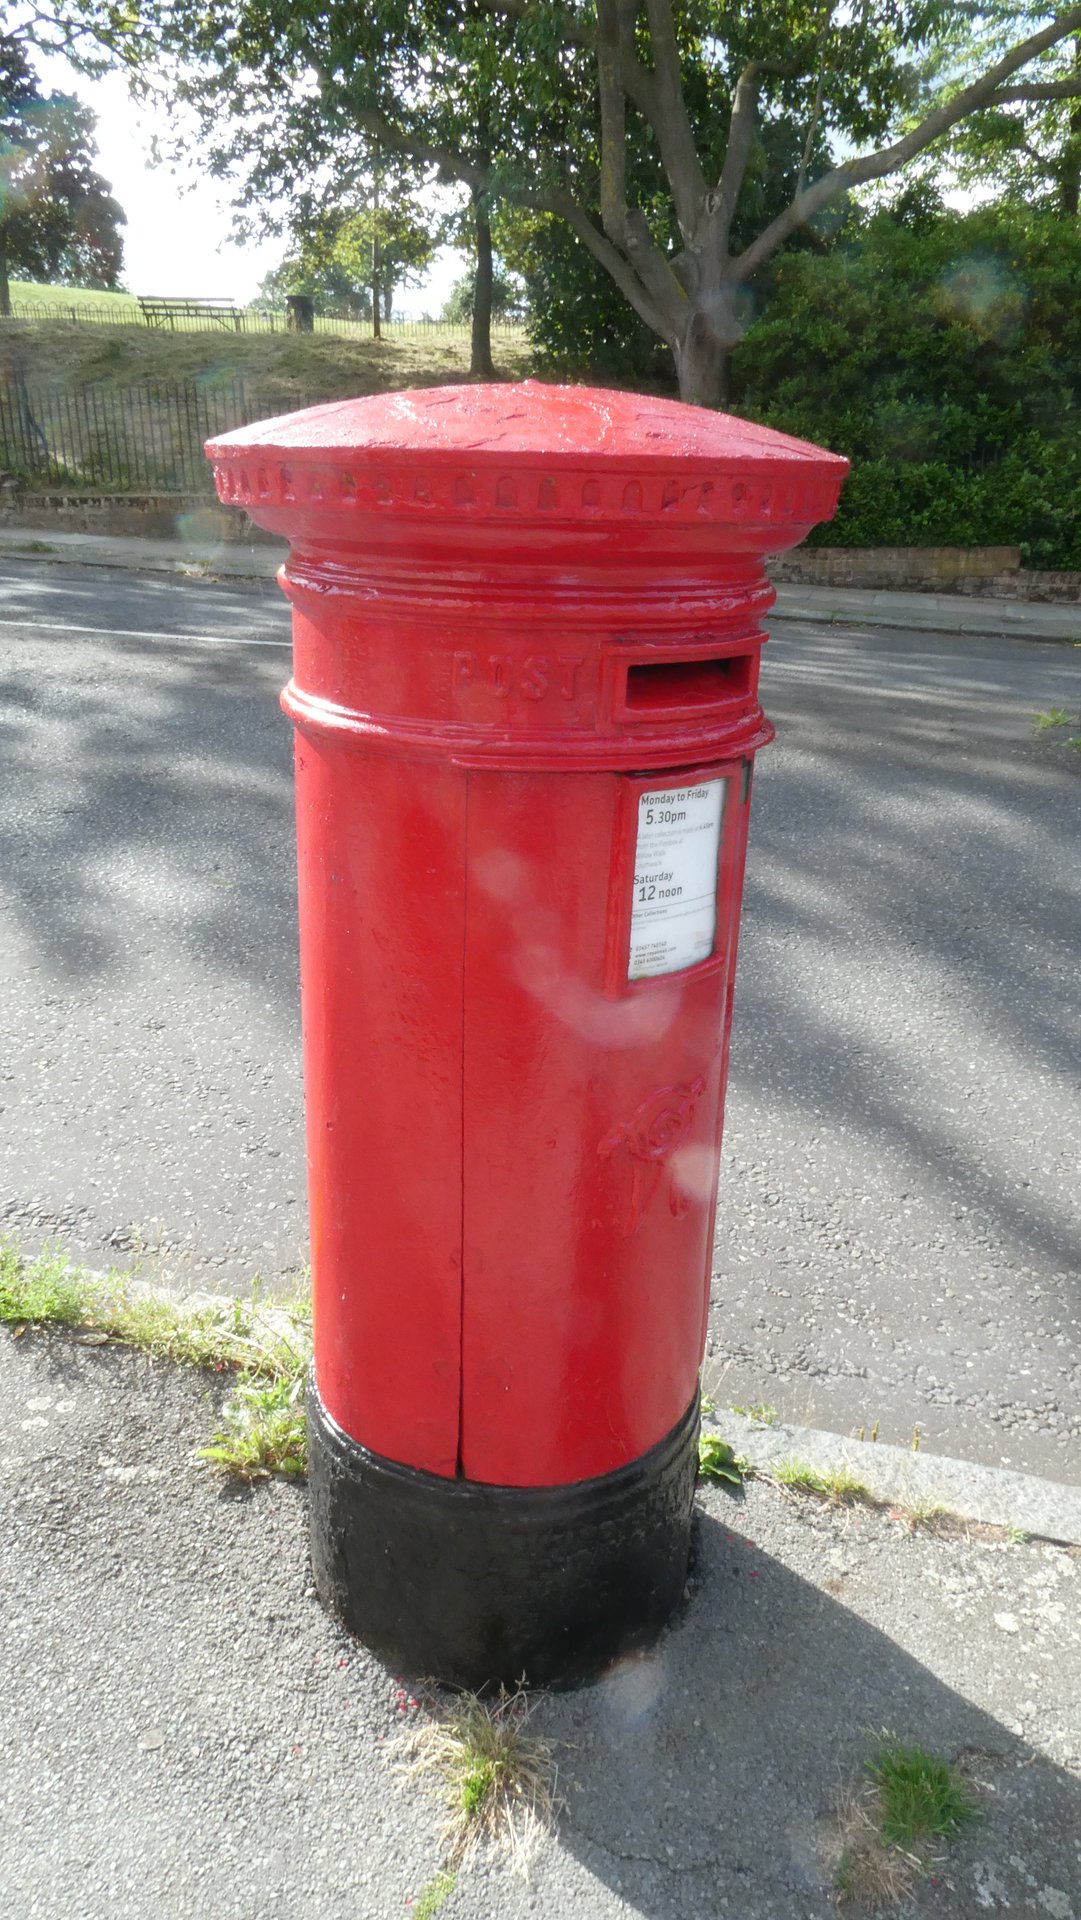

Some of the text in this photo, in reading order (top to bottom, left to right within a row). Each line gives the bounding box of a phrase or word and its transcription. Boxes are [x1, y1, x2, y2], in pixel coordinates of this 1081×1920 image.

[452, 651, 584, 701] POST
[641, 788, 709, 806] Monday to Friday
[646, 809, 687, 825] 5.30pm
[634, 872, 674, 885] Saturday
[638, 885, 683, 902] 12 noon
